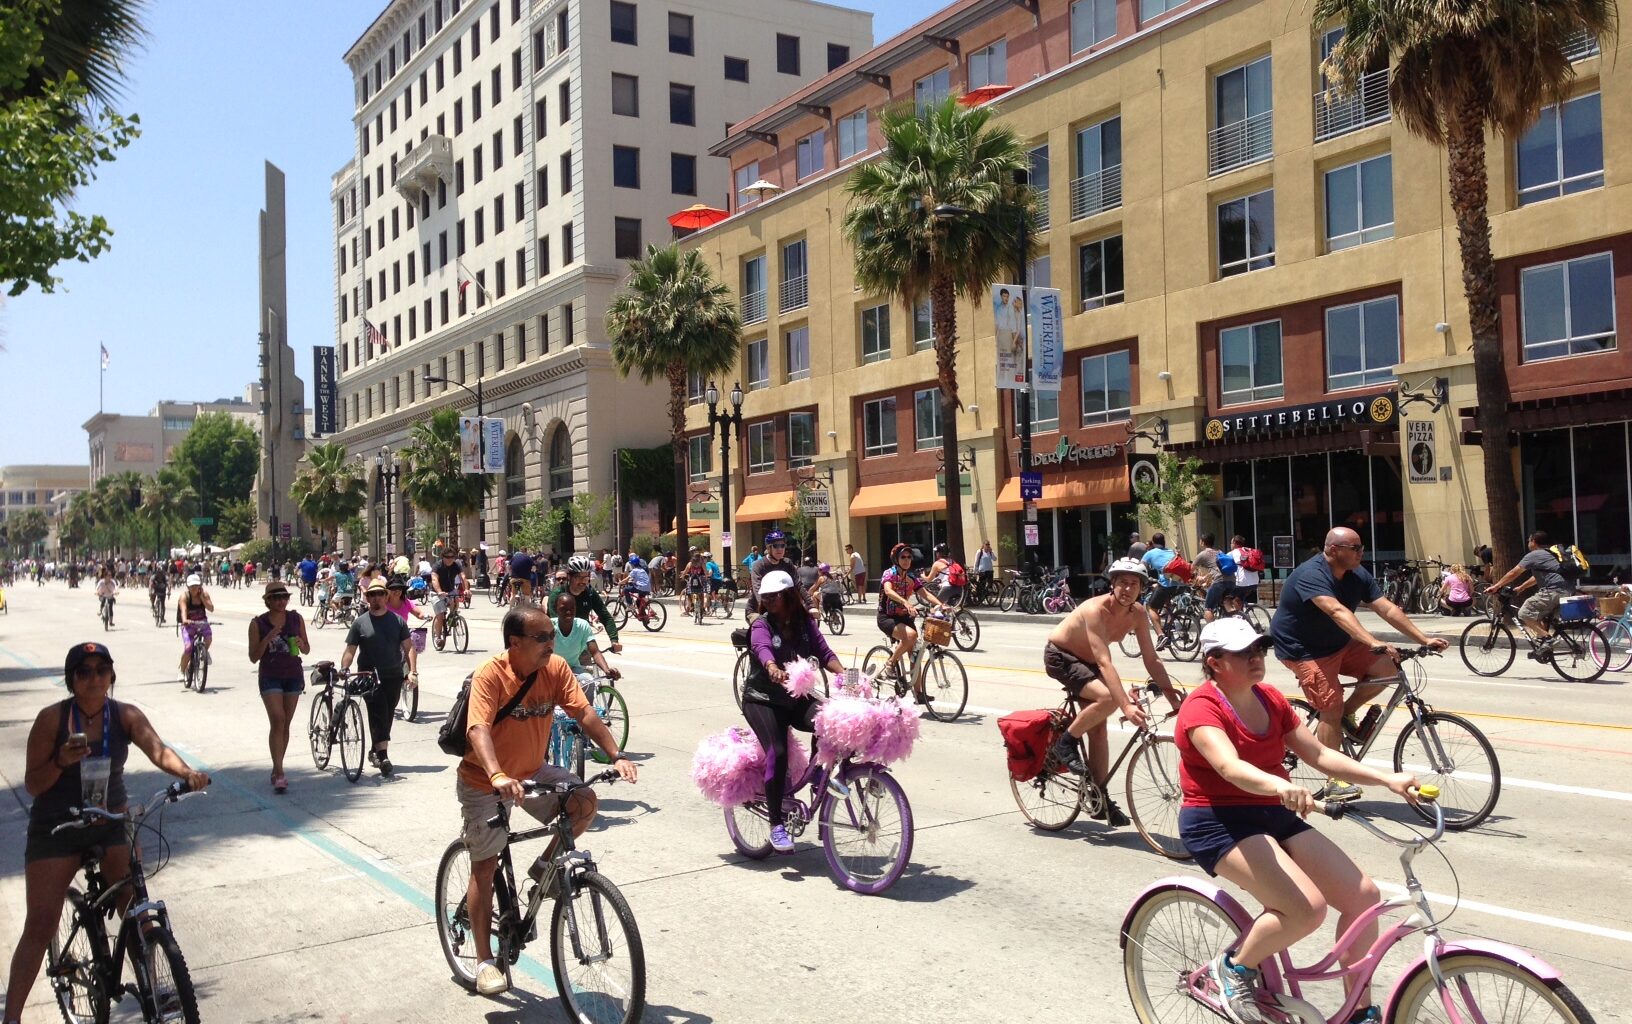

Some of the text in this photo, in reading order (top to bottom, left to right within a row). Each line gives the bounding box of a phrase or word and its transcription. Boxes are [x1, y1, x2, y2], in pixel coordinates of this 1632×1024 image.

[1041, 294, 1054, 369] WATERFALL
[320, 347, 328, 383] BANK
[320, 395, 329, 431] WEST
[1222, 401, 1365, 432] SETTEBELLO
[1409, 422, 1433, 431] VERA
[1409, 432, 1434, 441] PIZZA
